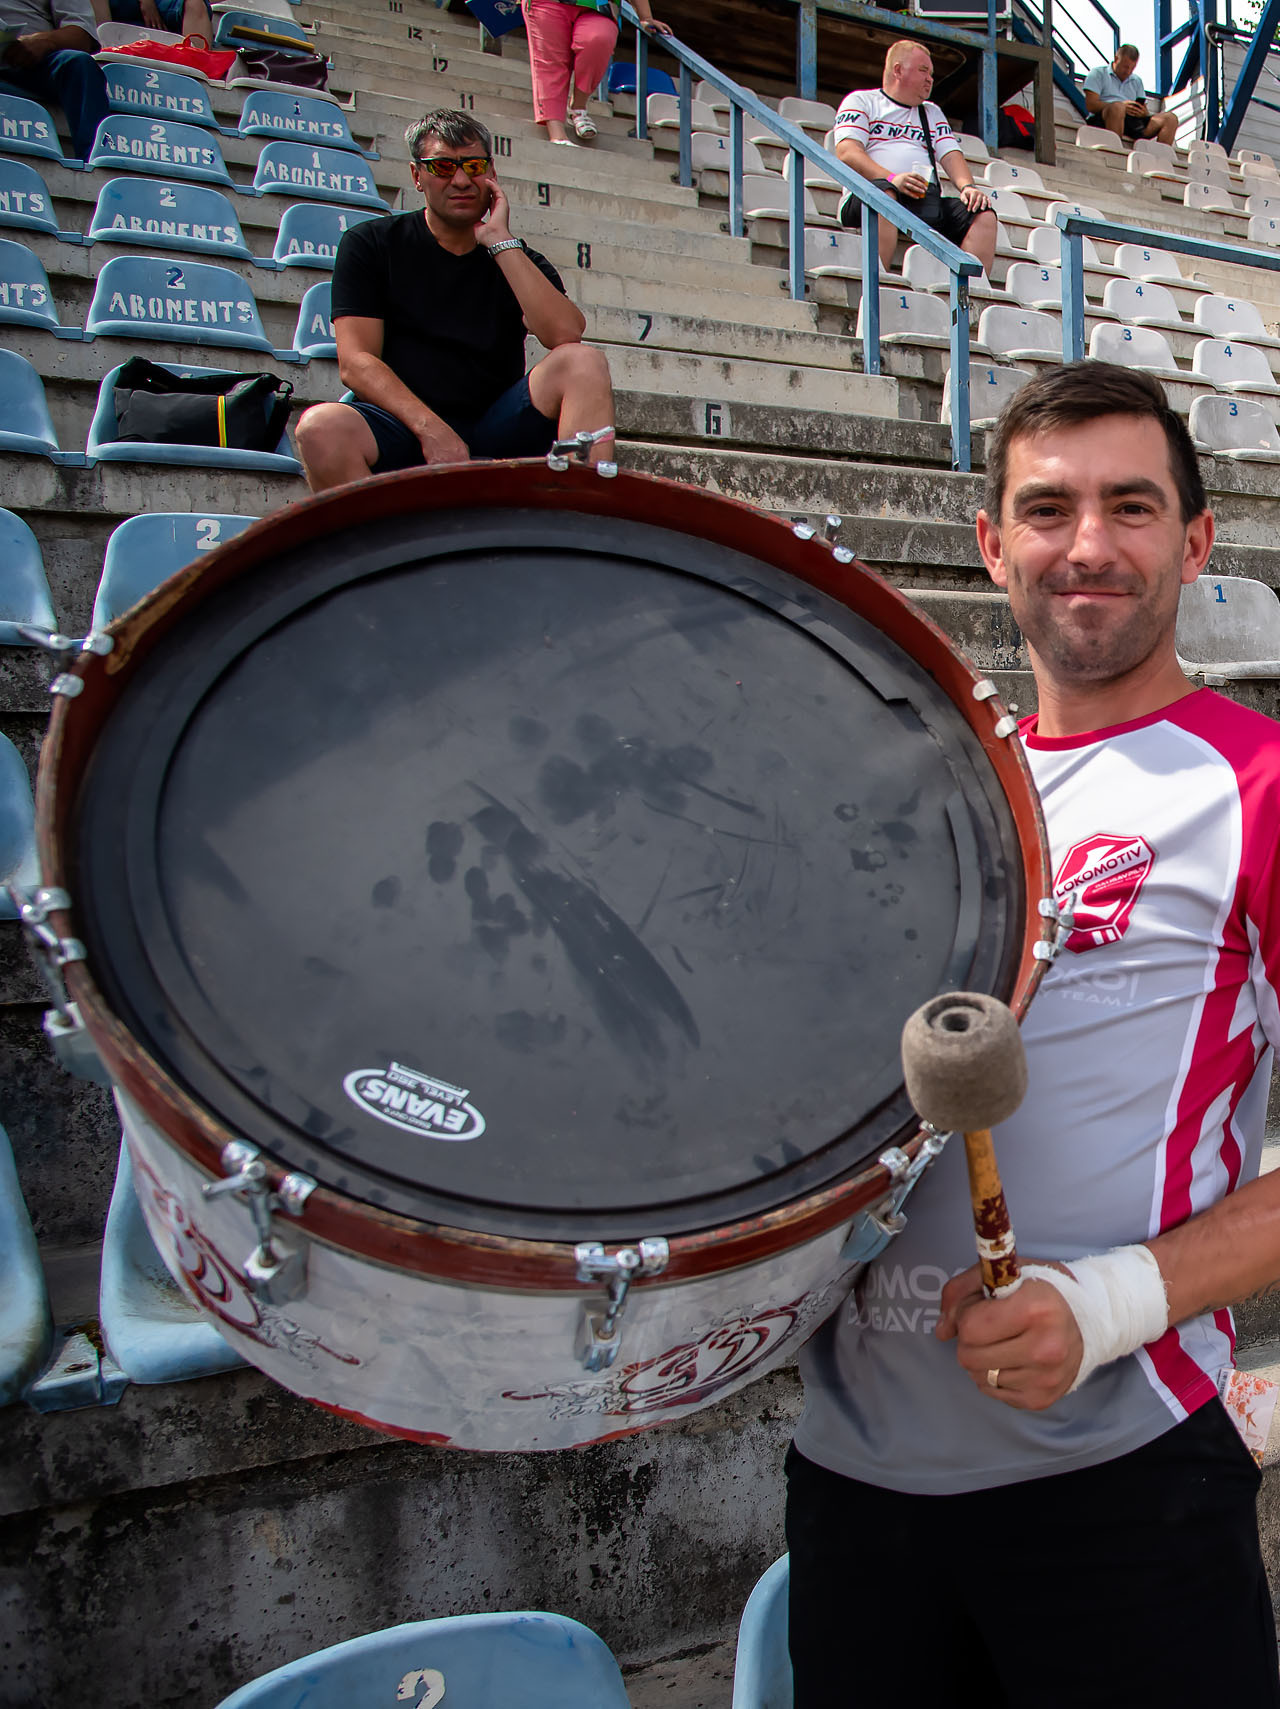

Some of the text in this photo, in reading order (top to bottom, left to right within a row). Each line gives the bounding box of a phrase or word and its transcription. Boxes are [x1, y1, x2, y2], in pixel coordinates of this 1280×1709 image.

[146, 72, 160, 88] 2
[460, 93, 474, 110] 11
[248, 110, 344, 138] ABONENTS
[151, 124, 167, 142] 2
[101, 132, 215, 165] ABONENTS
[717, 139, 726, 150] 1
[312, 152, 321, 168] 1
[263, 161, 369, 192] ABONENTS
[1011, 168, 1018, 178] 5
[159, 187, 177, 208] 2
[538, 183, 550, 206] 9
[991, 190, 999, 200] 4
[112, 213, 239, 245] ABONENTS
[1269, 221, 1276, 229] 6
[829, 235, 839, 248] 1
[577, 243, 592, 268] 8
[1142, 251, 1151, 262] 5
[165, 266, 186, 290] 2
[1041, 269, 1050, 281] 3
[1135, 285, 1144, 298] 4
[109, 292, 255, 324] ABONENTS
[899, 295, 910, 309] 1
[638, 314, 653, 341] 7
[1122, 329, 1132, 341] 3
[1223, 345, 1233, 358] 4
[986, 369, 998, 385] 1
[1228, 402, 1239, 417] 3
[705, 403, 722, 436] 6
[195, 519, 223, 550] 2
[1214, 583, 1227, 604] 1
[1056, 846, 1141, 898] LOKOMOTIV
[361, 1078, 469, 1133] EVANS
